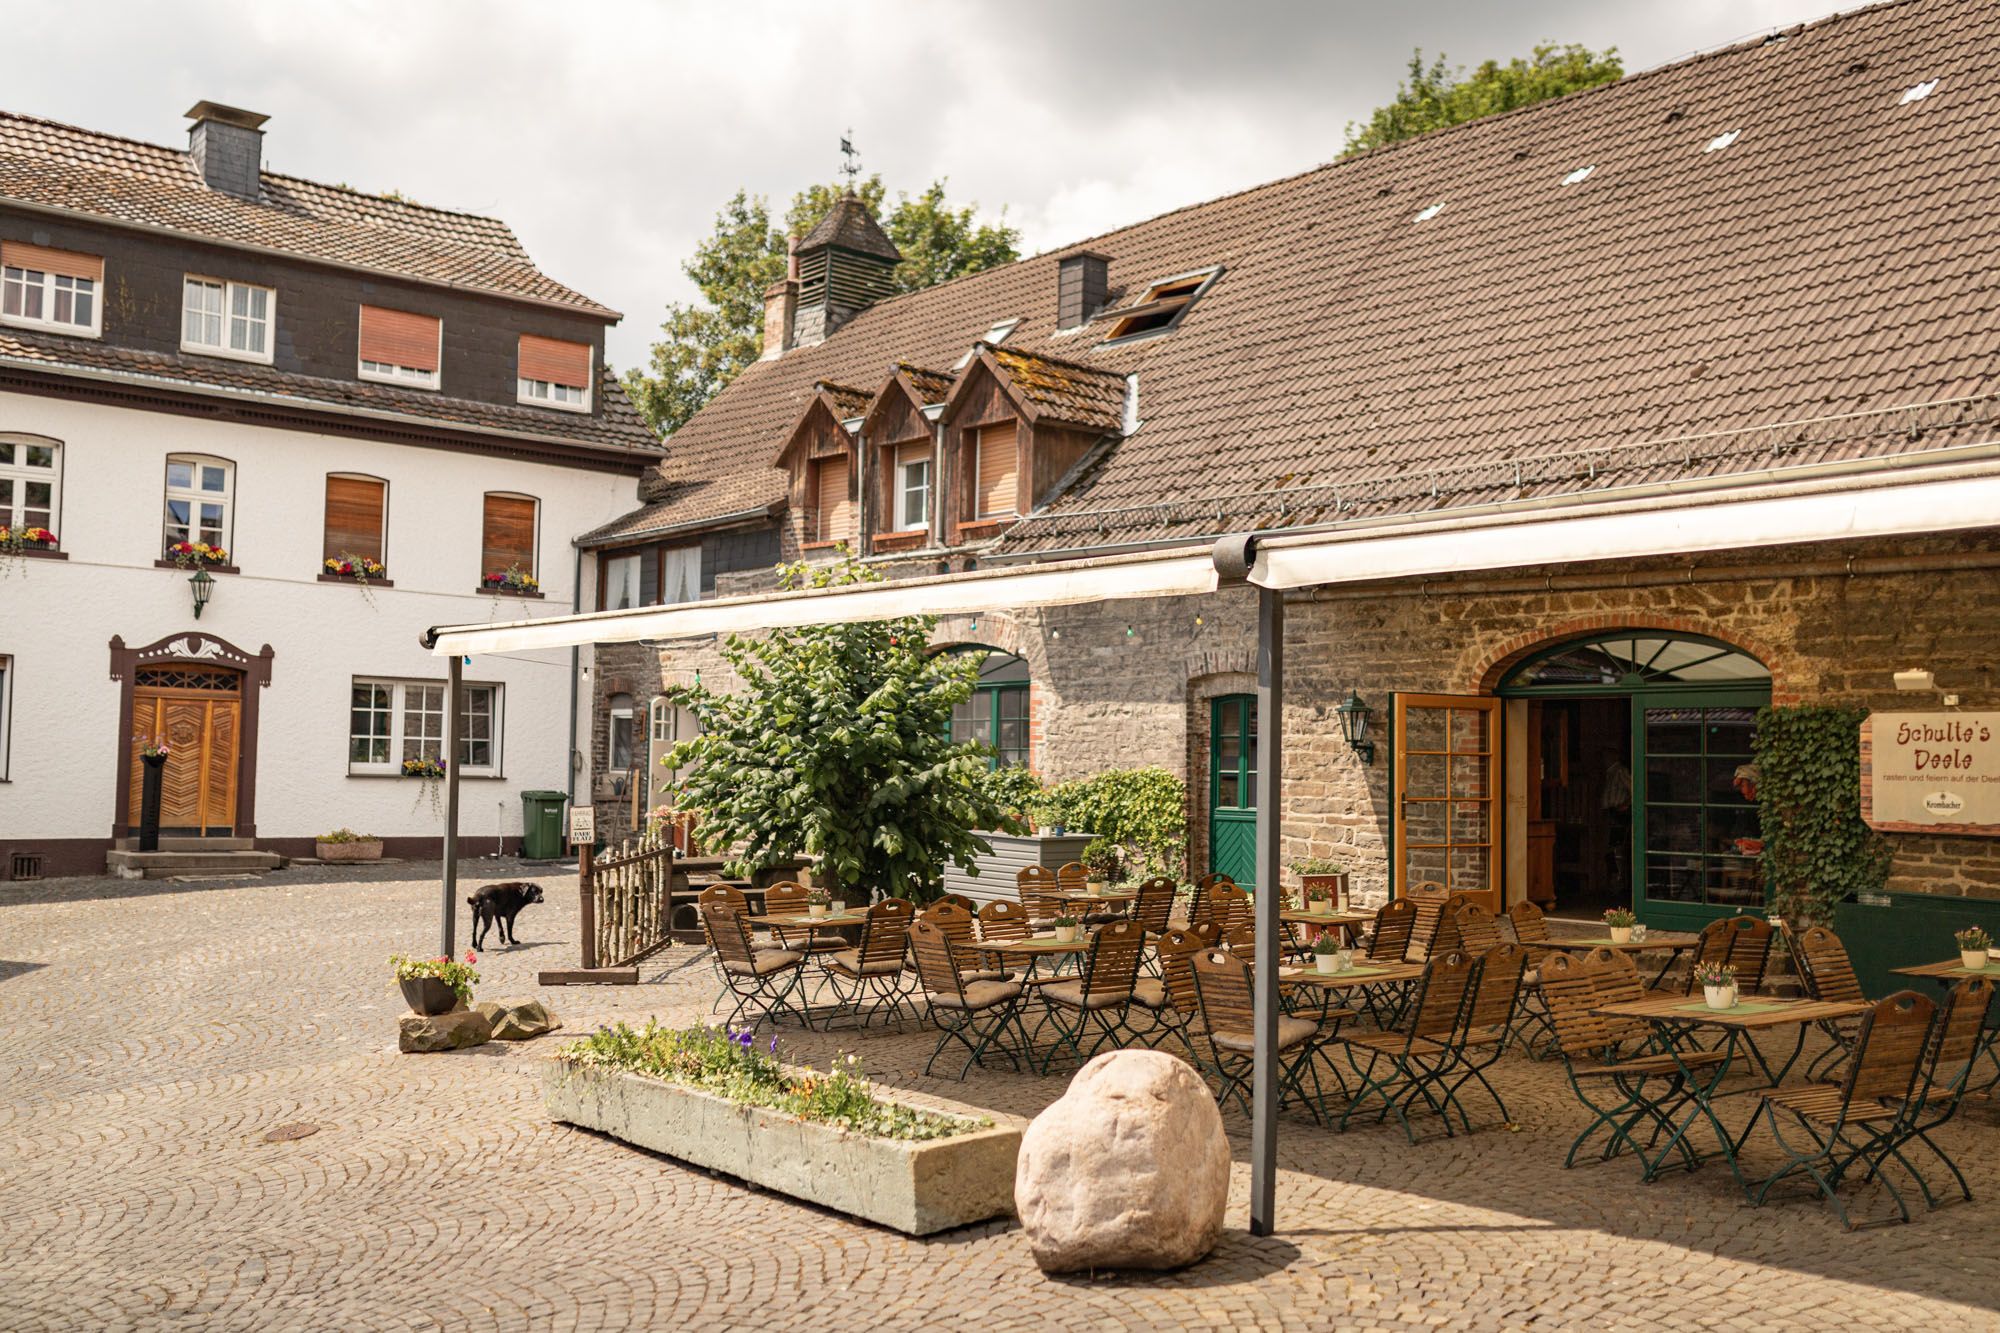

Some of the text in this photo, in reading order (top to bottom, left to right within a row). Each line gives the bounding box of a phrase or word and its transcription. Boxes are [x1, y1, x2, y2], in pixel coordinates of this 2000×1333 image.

[1896, 720, 1991, 745] Schulte's
[1914, 748, 1972, 771] Deele
[1909, 774, 1924, 782] und
[1926, 774, 1949, 782] feiern
[1951, 774, 1963, 782] auf
[1965, 774, 1978, 783] der
[1926, 800, 1961, 809] Krombacher
